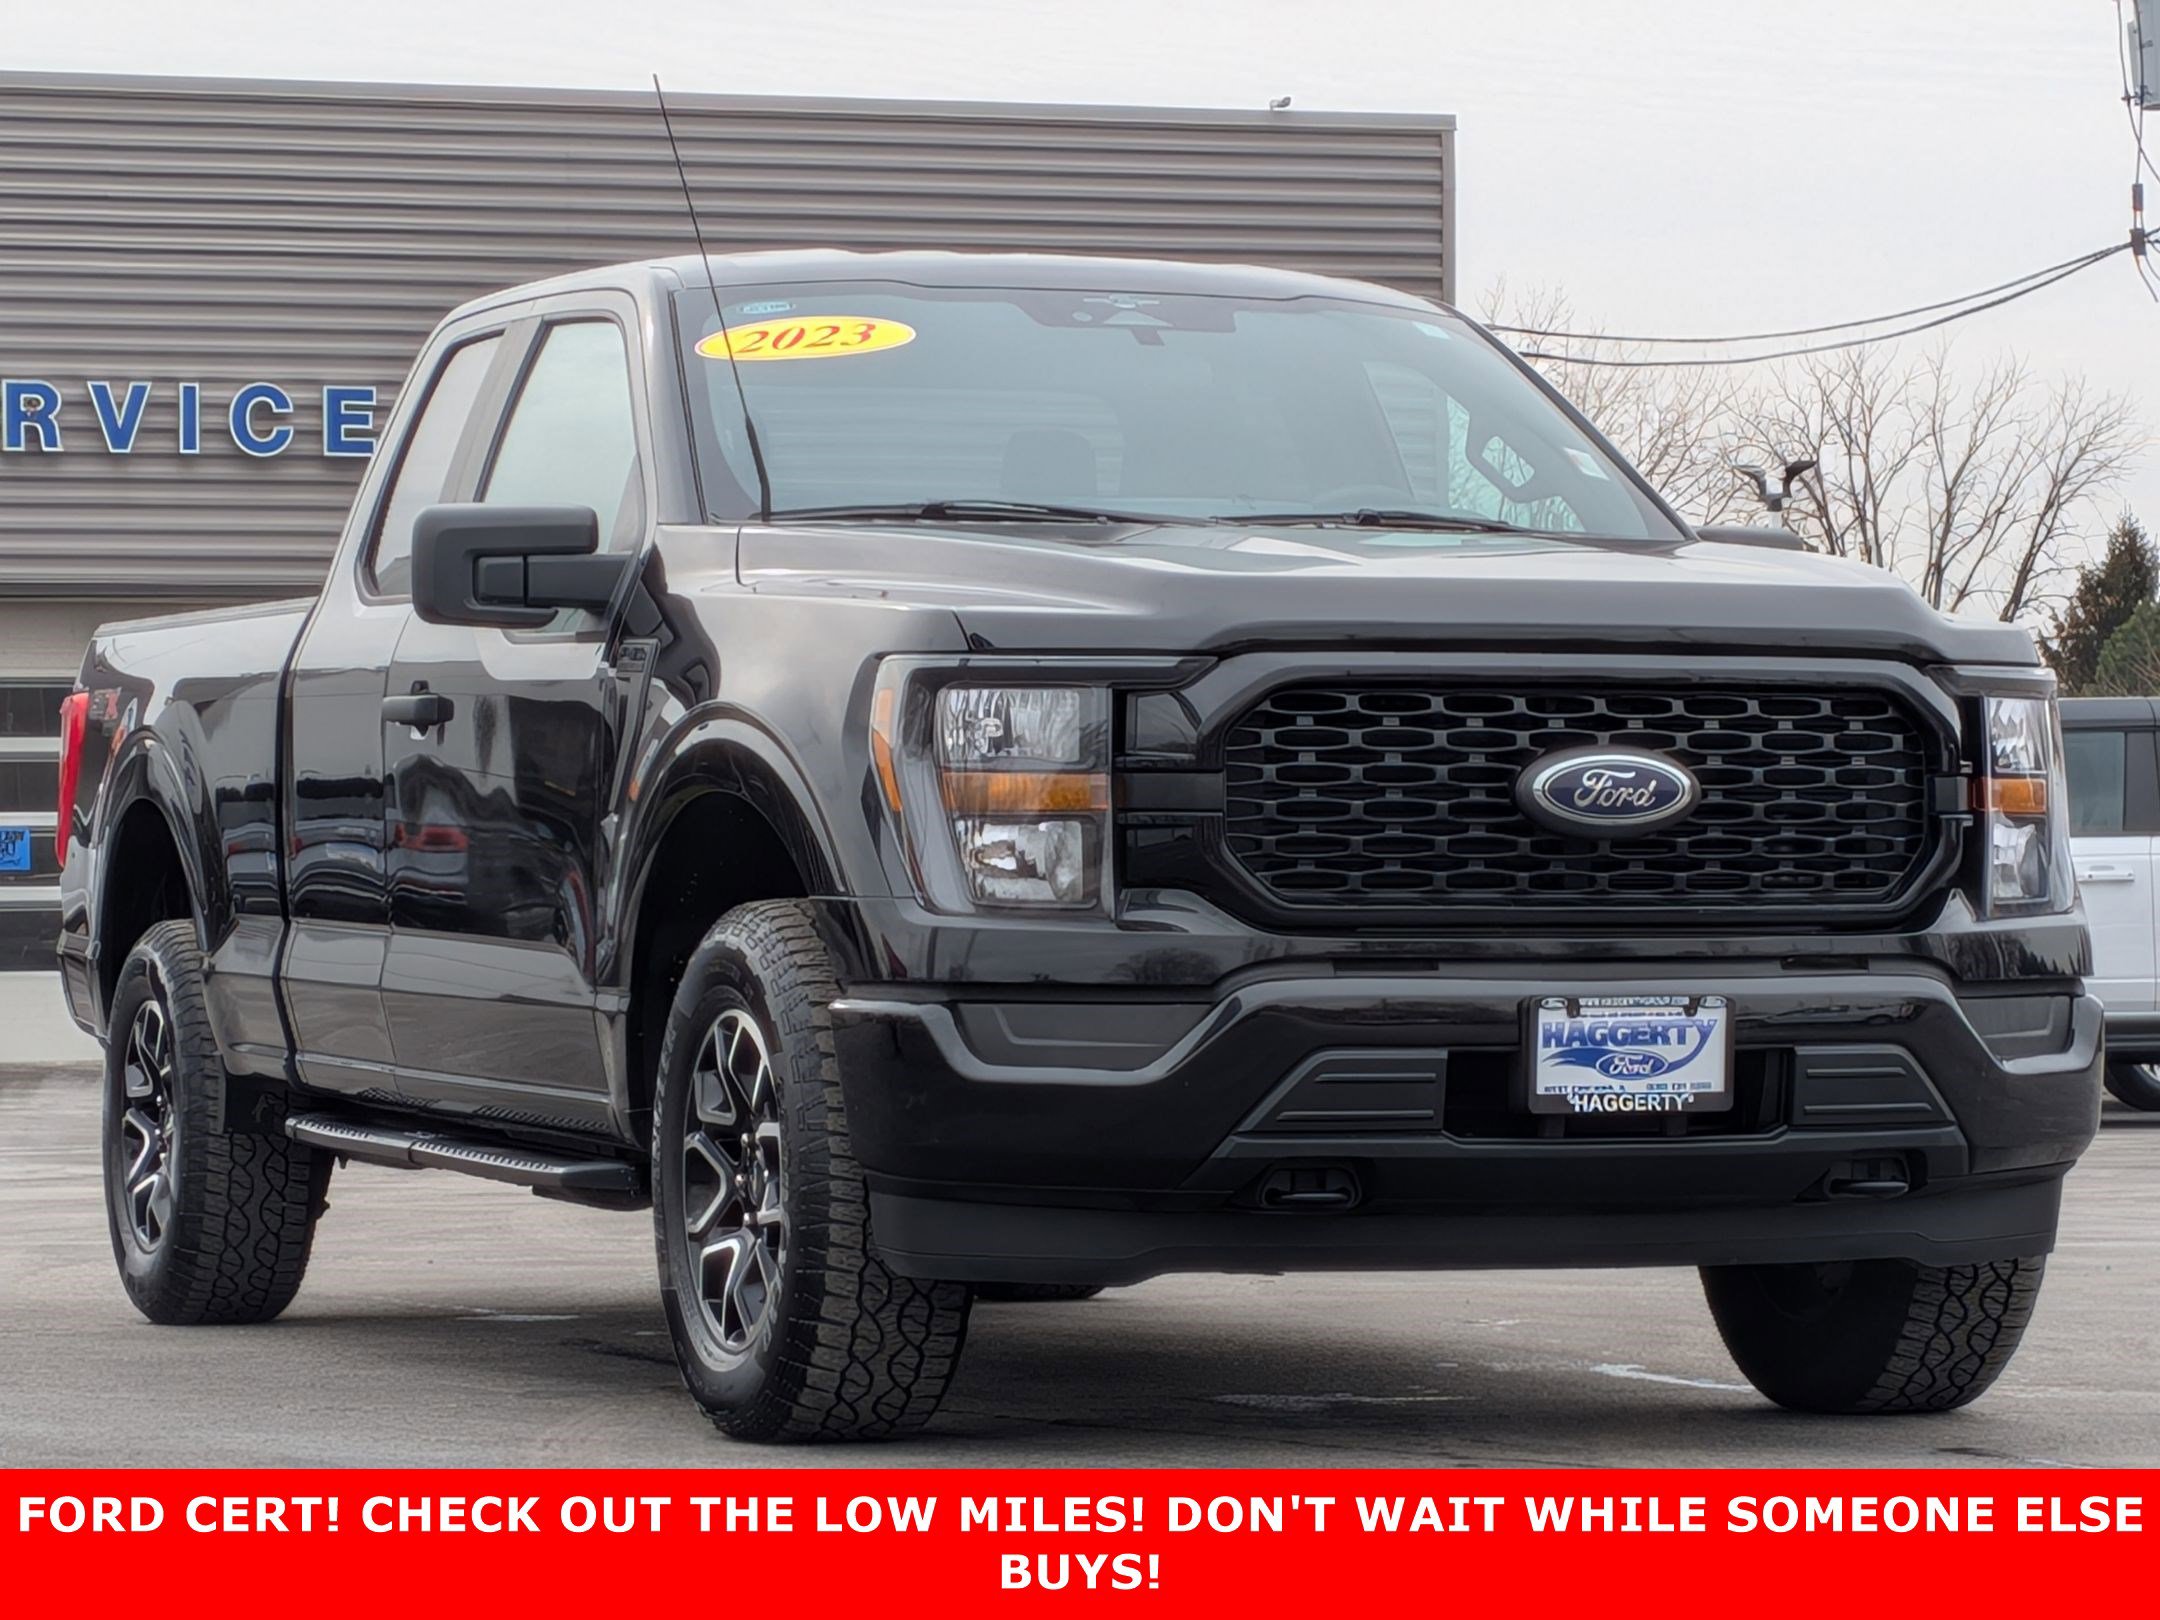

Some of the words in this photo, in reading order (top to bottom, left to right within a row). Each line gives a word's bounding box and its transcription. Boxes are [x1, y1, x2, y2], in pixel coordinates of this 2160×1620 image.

[735, 323, 876, 354] 2023
[2, 379, 377, 457] RVICE
[1573, 768, 1657, 808] Ford
[1541, 1018, 1718, 1049] HAGGERTY
[1608, 1053, 1654, 1075] Ford
[1573, 1093, 1685, 1113] HAGGERTY
